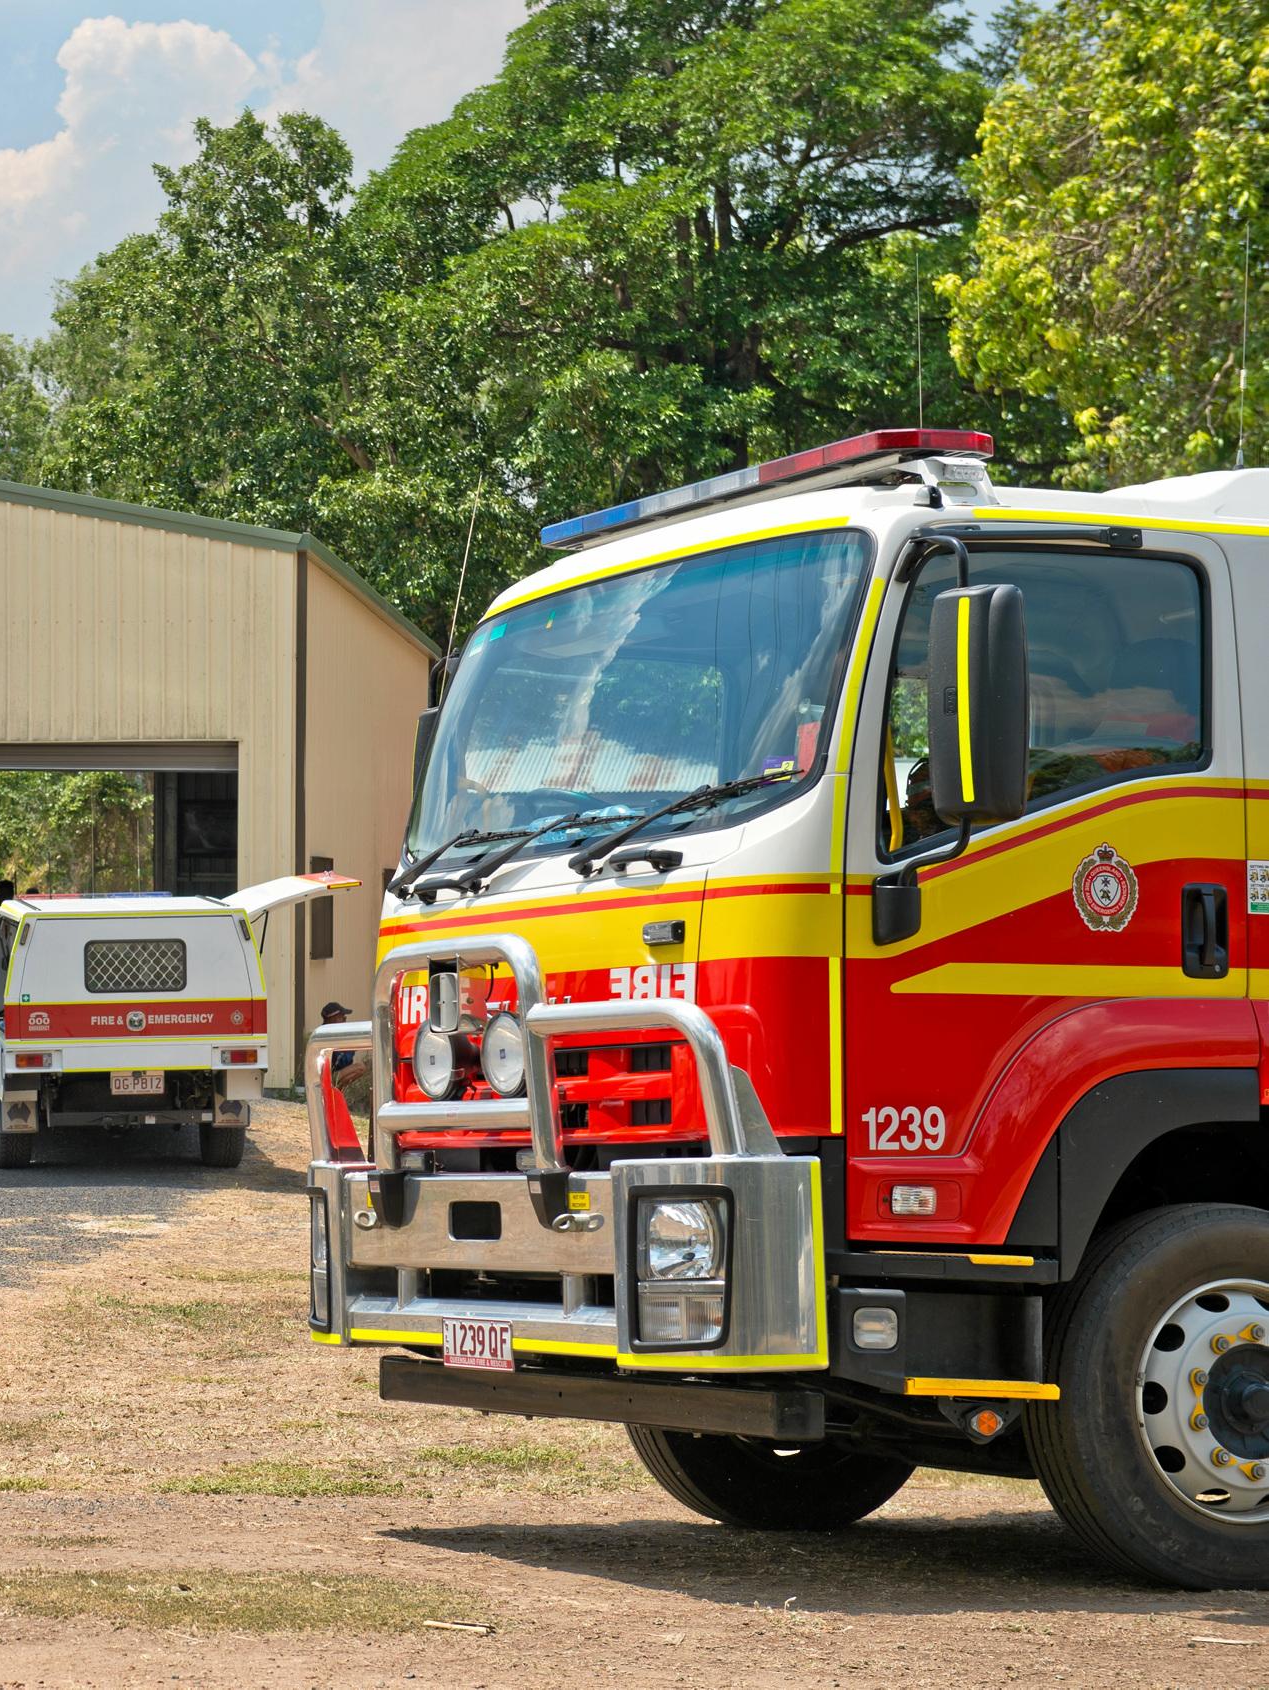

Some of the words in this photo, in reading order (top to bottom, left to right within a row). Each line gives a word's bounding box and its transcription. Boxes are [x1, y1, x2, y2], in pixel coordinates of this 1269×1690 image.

[1091, 865, 1122, 878] QUEENSLAND
[90, 1015, 115, 1025] FIRE
[116, 1015, 124, 1025] &
[147, 1013, 214, 1025] EMERGENCY
[862, 1106, 946, 1151] 1239
[453, 1323, 485, 1356] 1239
[488, 1326, 509, 1359] QF
[450, 1356, 476, 1365] QUEENSLAND
[476, 1358, 486, 1366] FIRE
[491, 1360, 508, 1368] RESCUE
